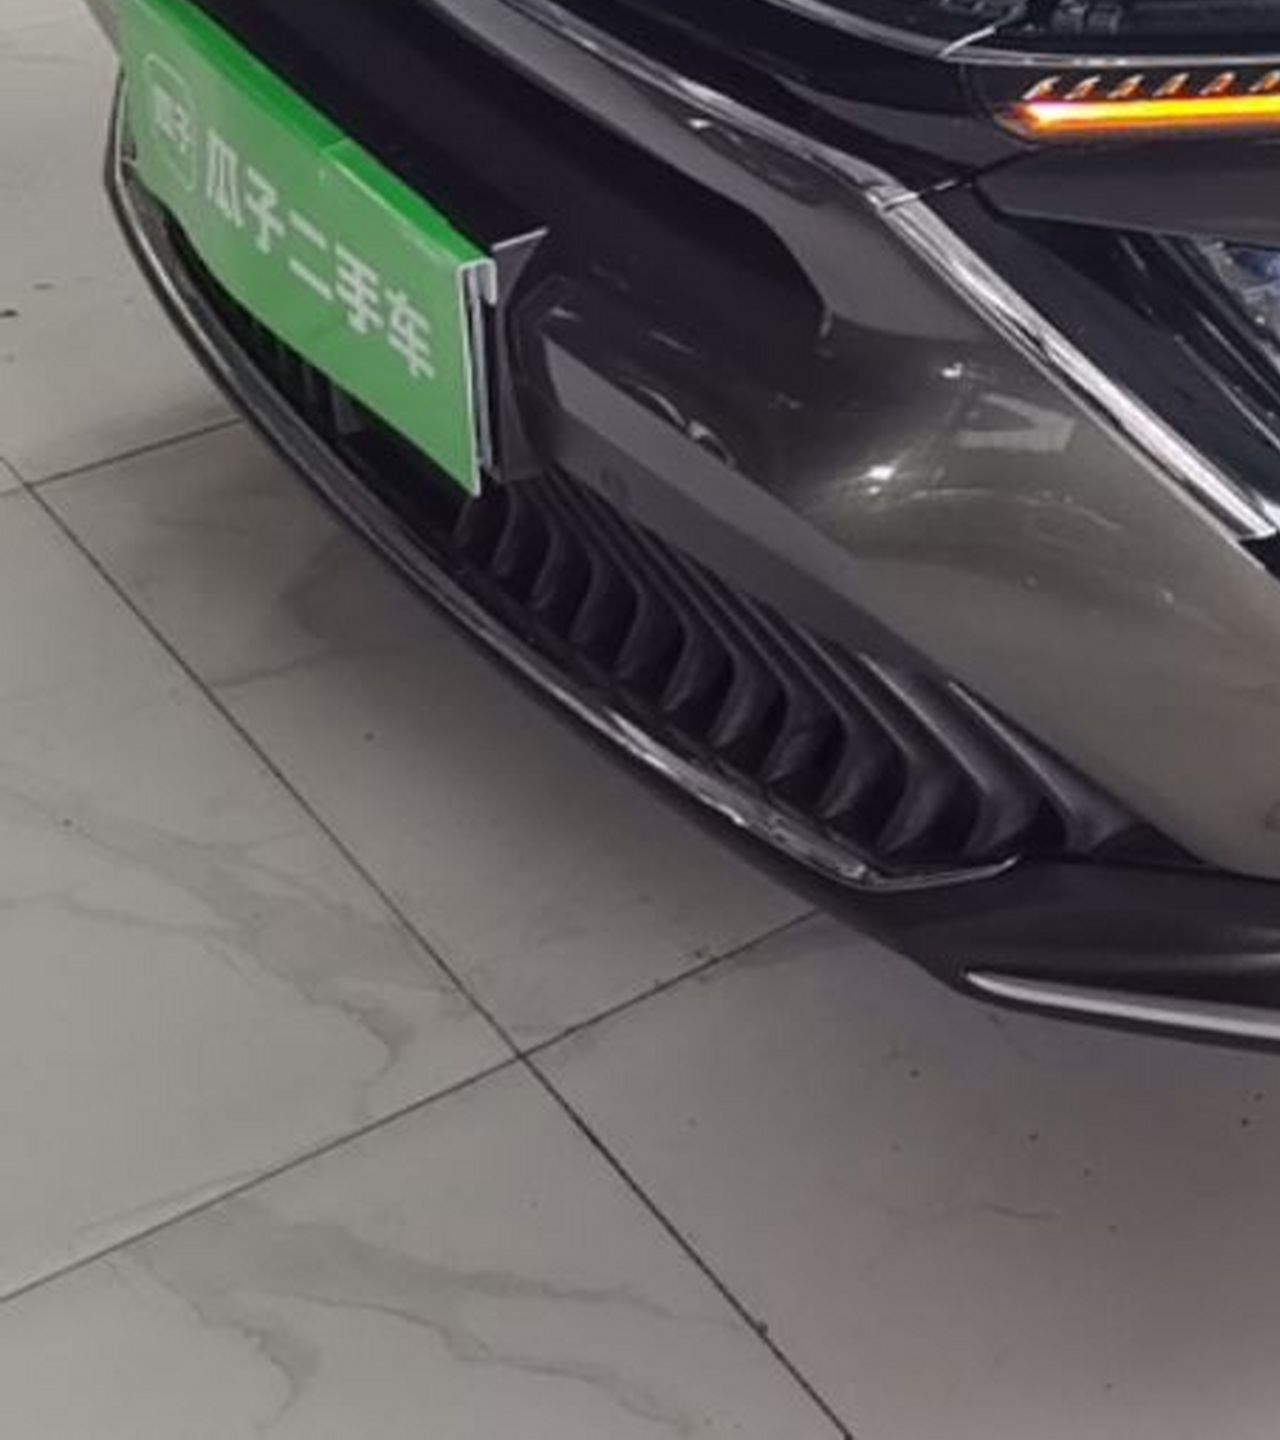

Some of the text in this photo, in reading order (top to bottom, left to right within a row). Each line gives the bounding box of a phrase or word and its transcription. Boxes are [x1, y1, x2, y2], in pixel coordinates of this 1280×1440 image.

[206, 129, 435, 379] 瓜子二手车
